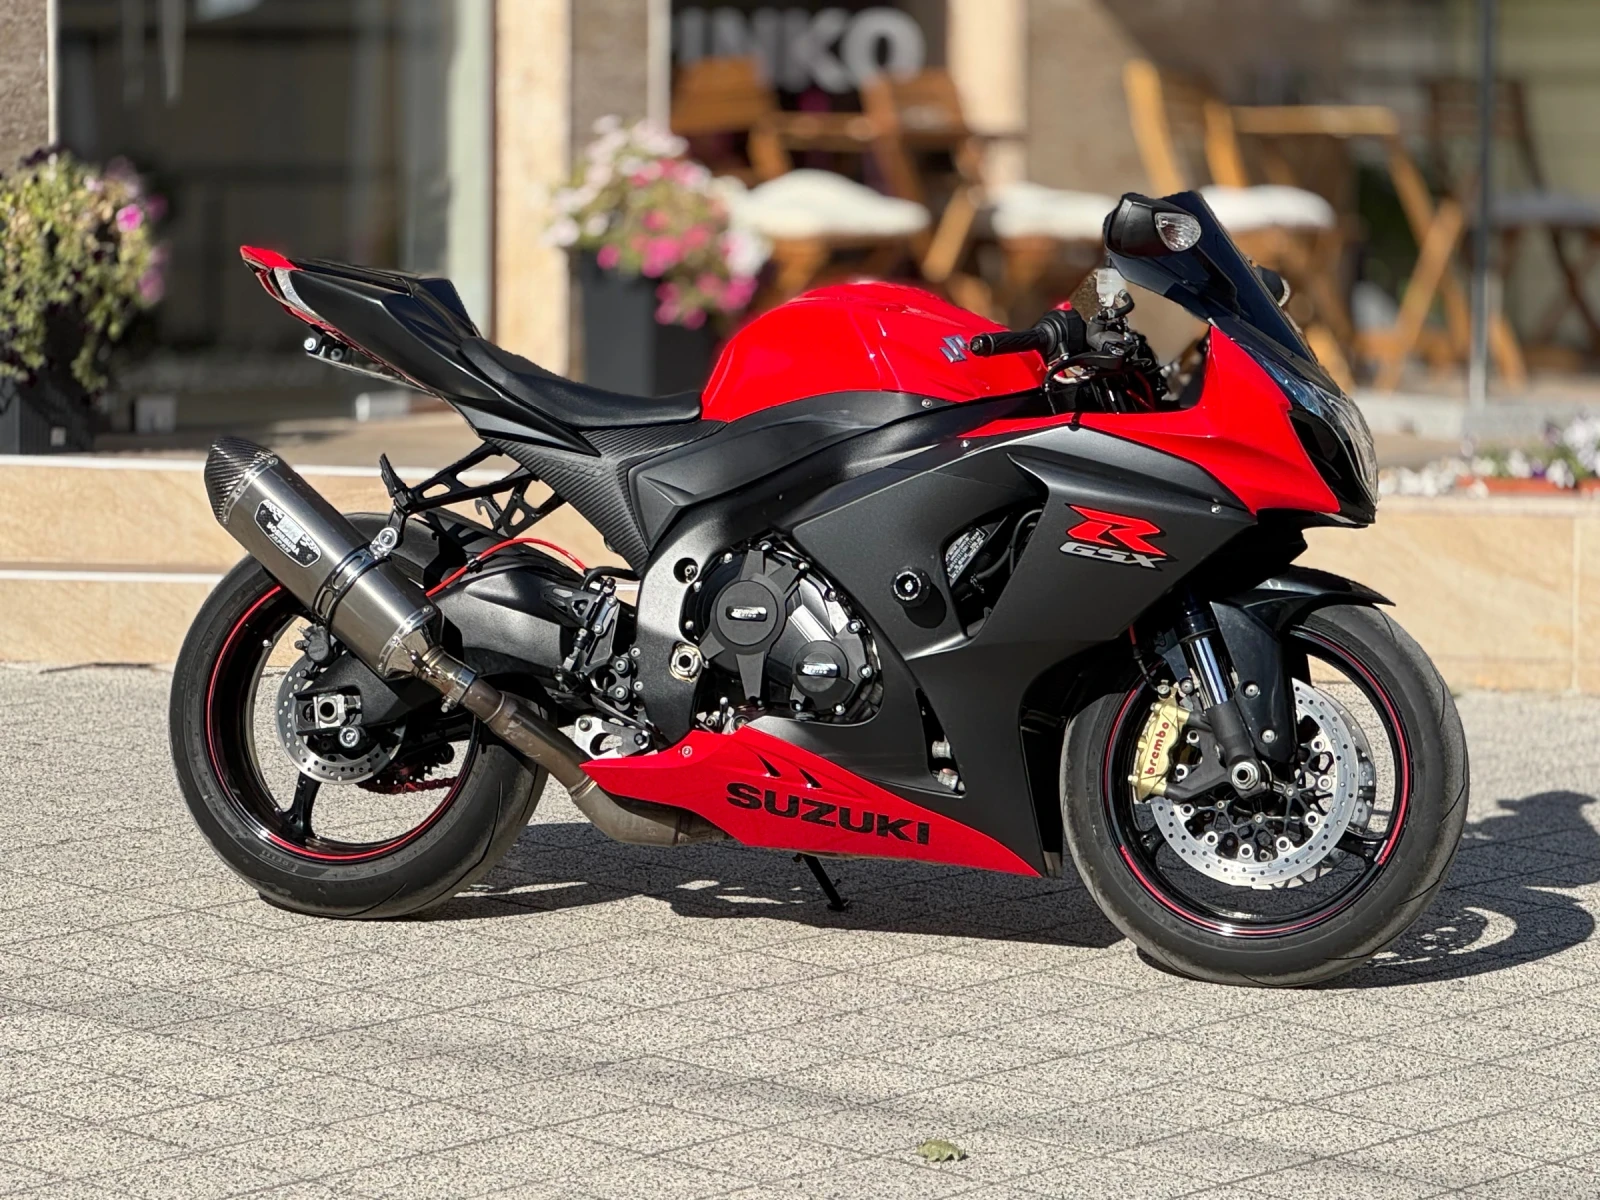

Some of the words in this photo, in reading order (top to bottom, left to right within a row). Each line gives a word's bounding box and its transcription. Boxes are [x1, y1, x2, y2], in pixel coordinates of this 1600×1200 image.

[673, 7, 927, 92] INKO
[1060, 541, 1167, 569] GSX
[1066, 504, 1168, 556] R
[1144, 721, 1170, 775] brembo
[726, 782, 930, 845] SUZUKI
